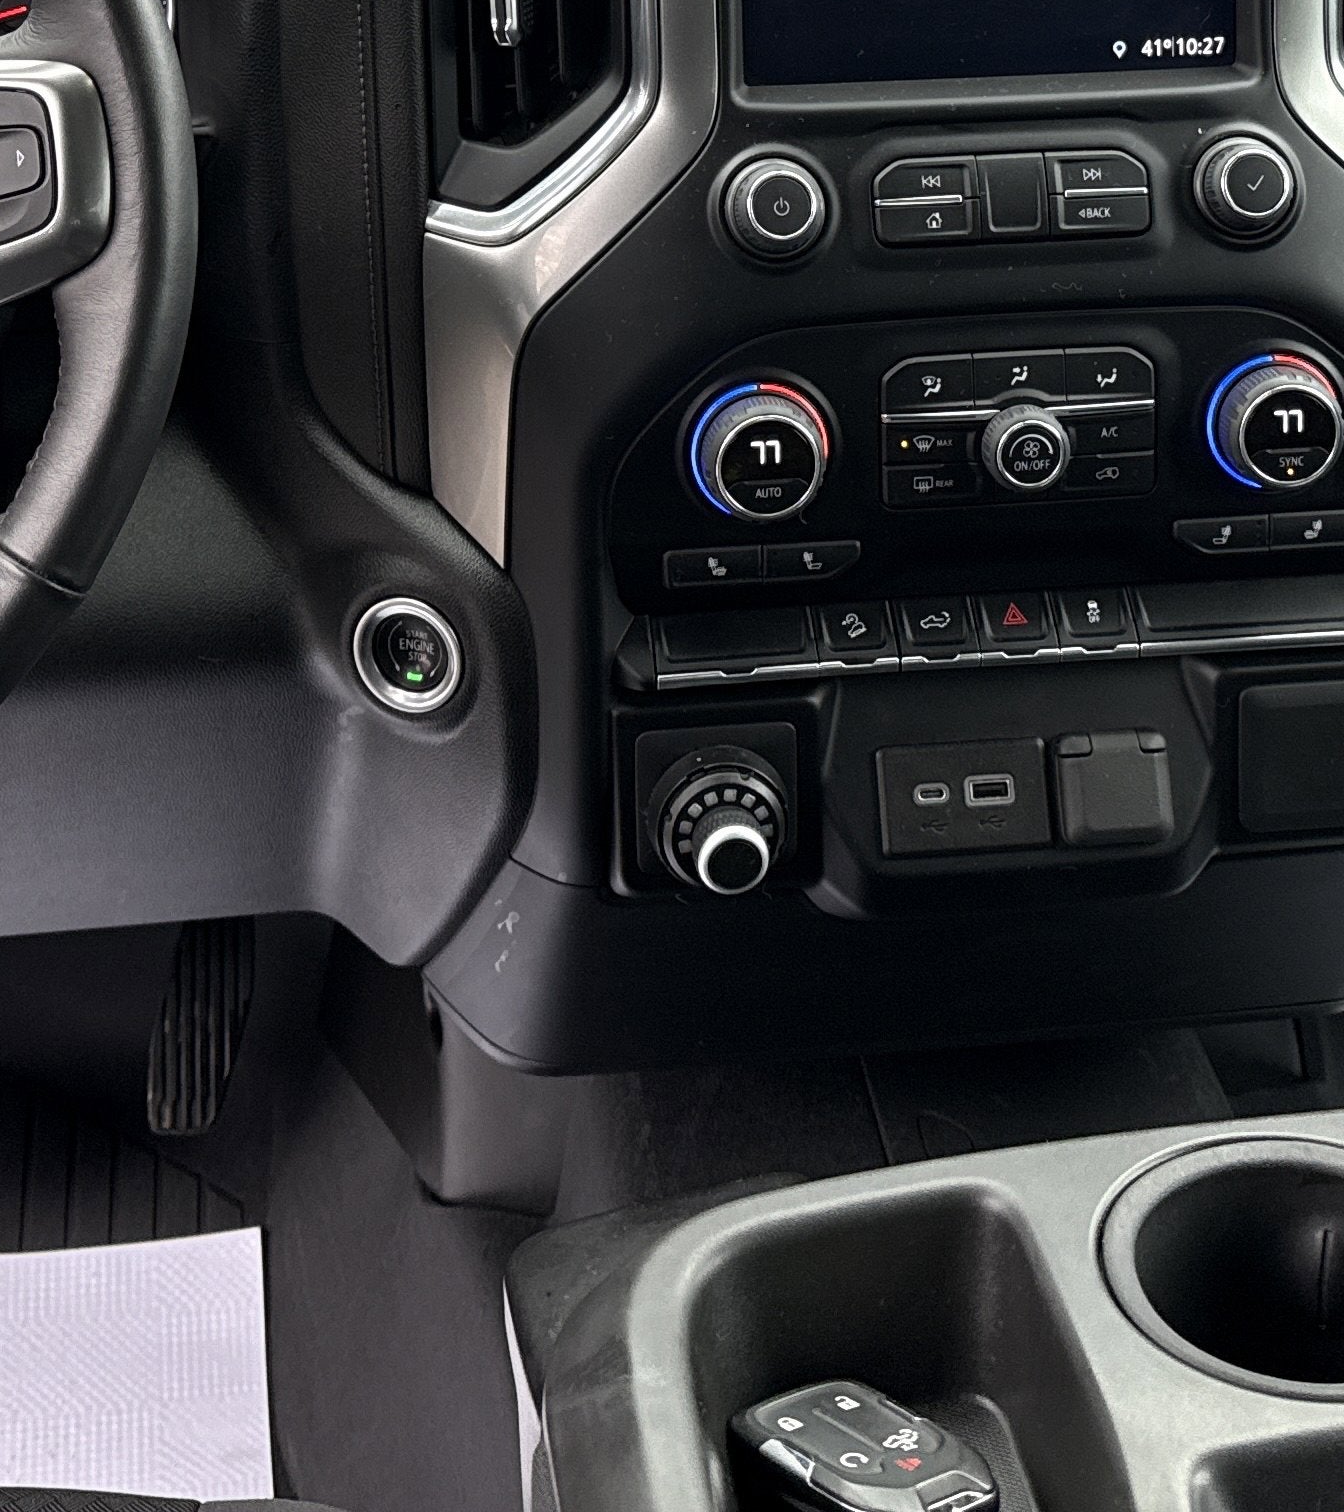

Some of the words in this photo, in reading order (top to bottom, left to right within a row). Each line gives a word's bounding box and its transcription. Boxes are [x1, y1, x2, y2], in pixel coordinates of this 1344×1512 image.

[1175, 36, 1225, 56] 10:27
[1086, 207, 1112, 219] BACK
[1273, 409, 1304, 434] 77
[1100, 426, 1119, 438] A/C
[936, 439, 954, 448] MAX
[750, 439, 782, 465] 77
[1013, 459, 1052, 472] ON/OFF
[1278, 456, 1305, 468] SYNC
[935, 479, 954, 488] REAR
[754, 487, 782, 499] AUTO
[405, 629, 429, 640] START
[399, 637, 435, 656] ENGINE
[408, 651, 427, 662] STOP
